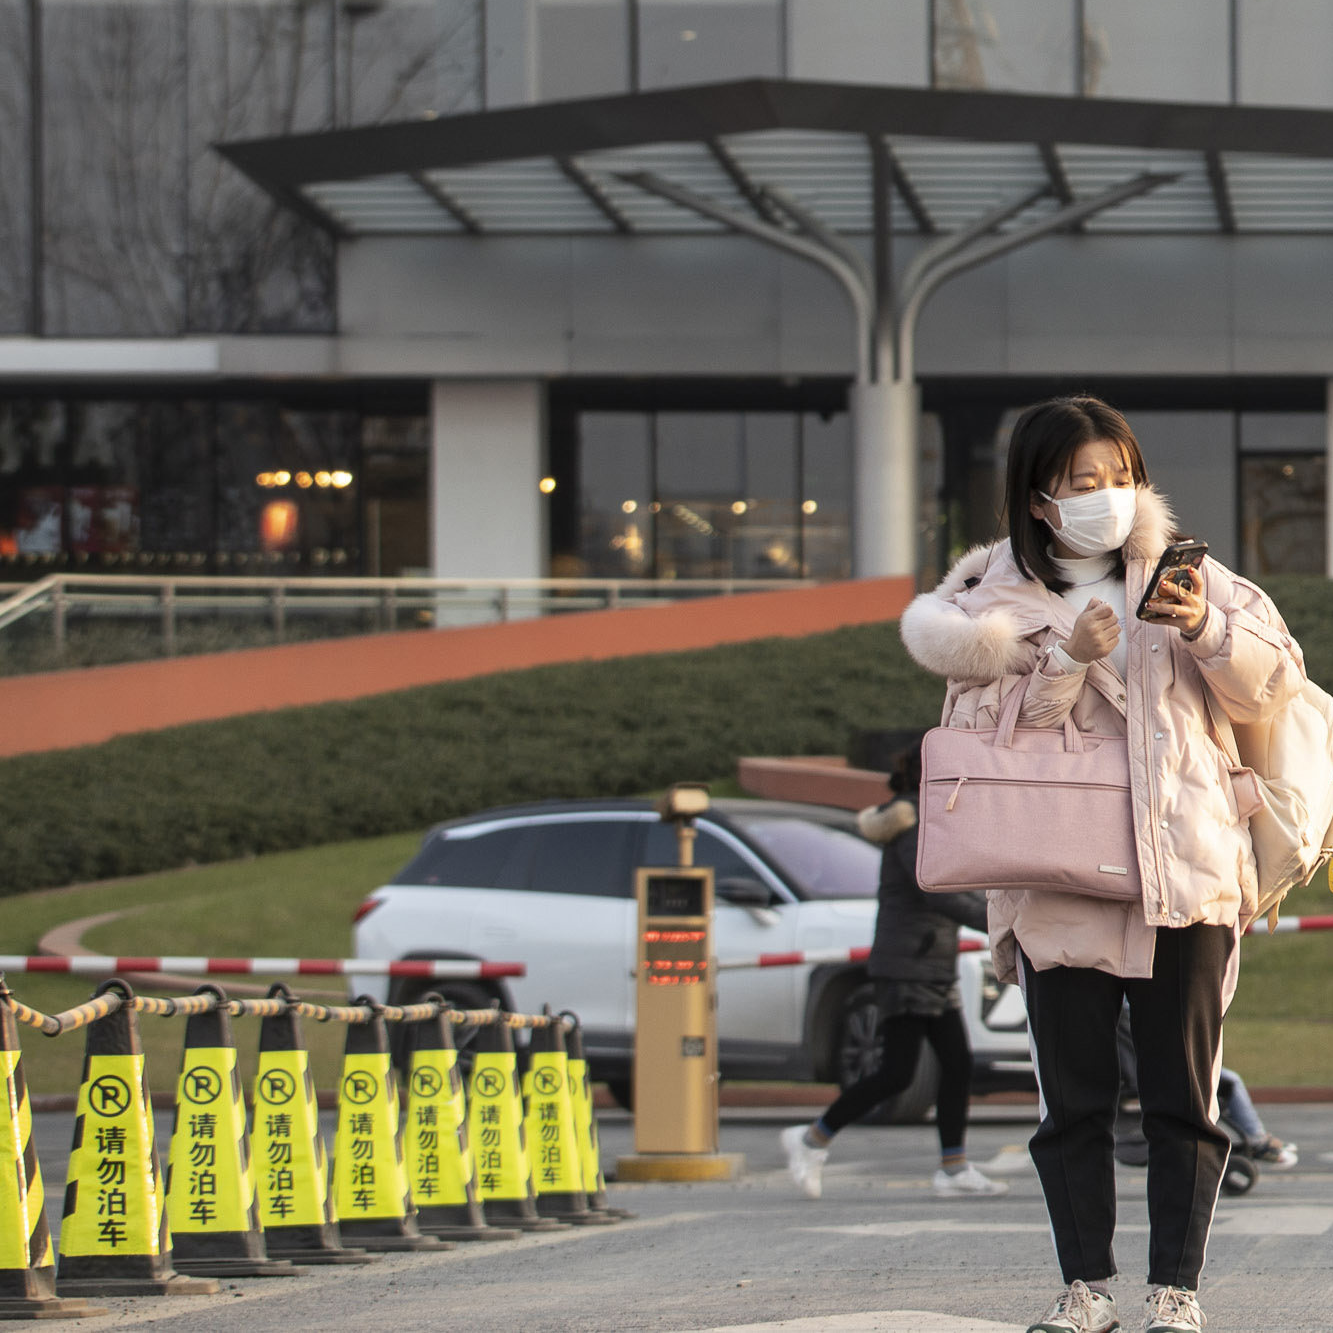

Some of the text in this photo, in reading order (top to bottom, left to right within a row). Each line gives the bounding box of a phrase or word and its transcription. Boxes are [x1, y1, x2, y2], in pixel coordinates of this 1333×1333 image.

[95, 1126, 128, 1248] 请勿泊车
[189, 1112, 217, 1226] 请勿泊车
[266, 1112, 295, 1219] 请勿泊车
[348, 1112, 376, 1211] 请勿泊车
[416, 1105, 440, 1198] 请勿泊车
[480, 1104, 502, 1192] 请勿泊车
[538, 1101, 562, 1185] 请勿泊车
